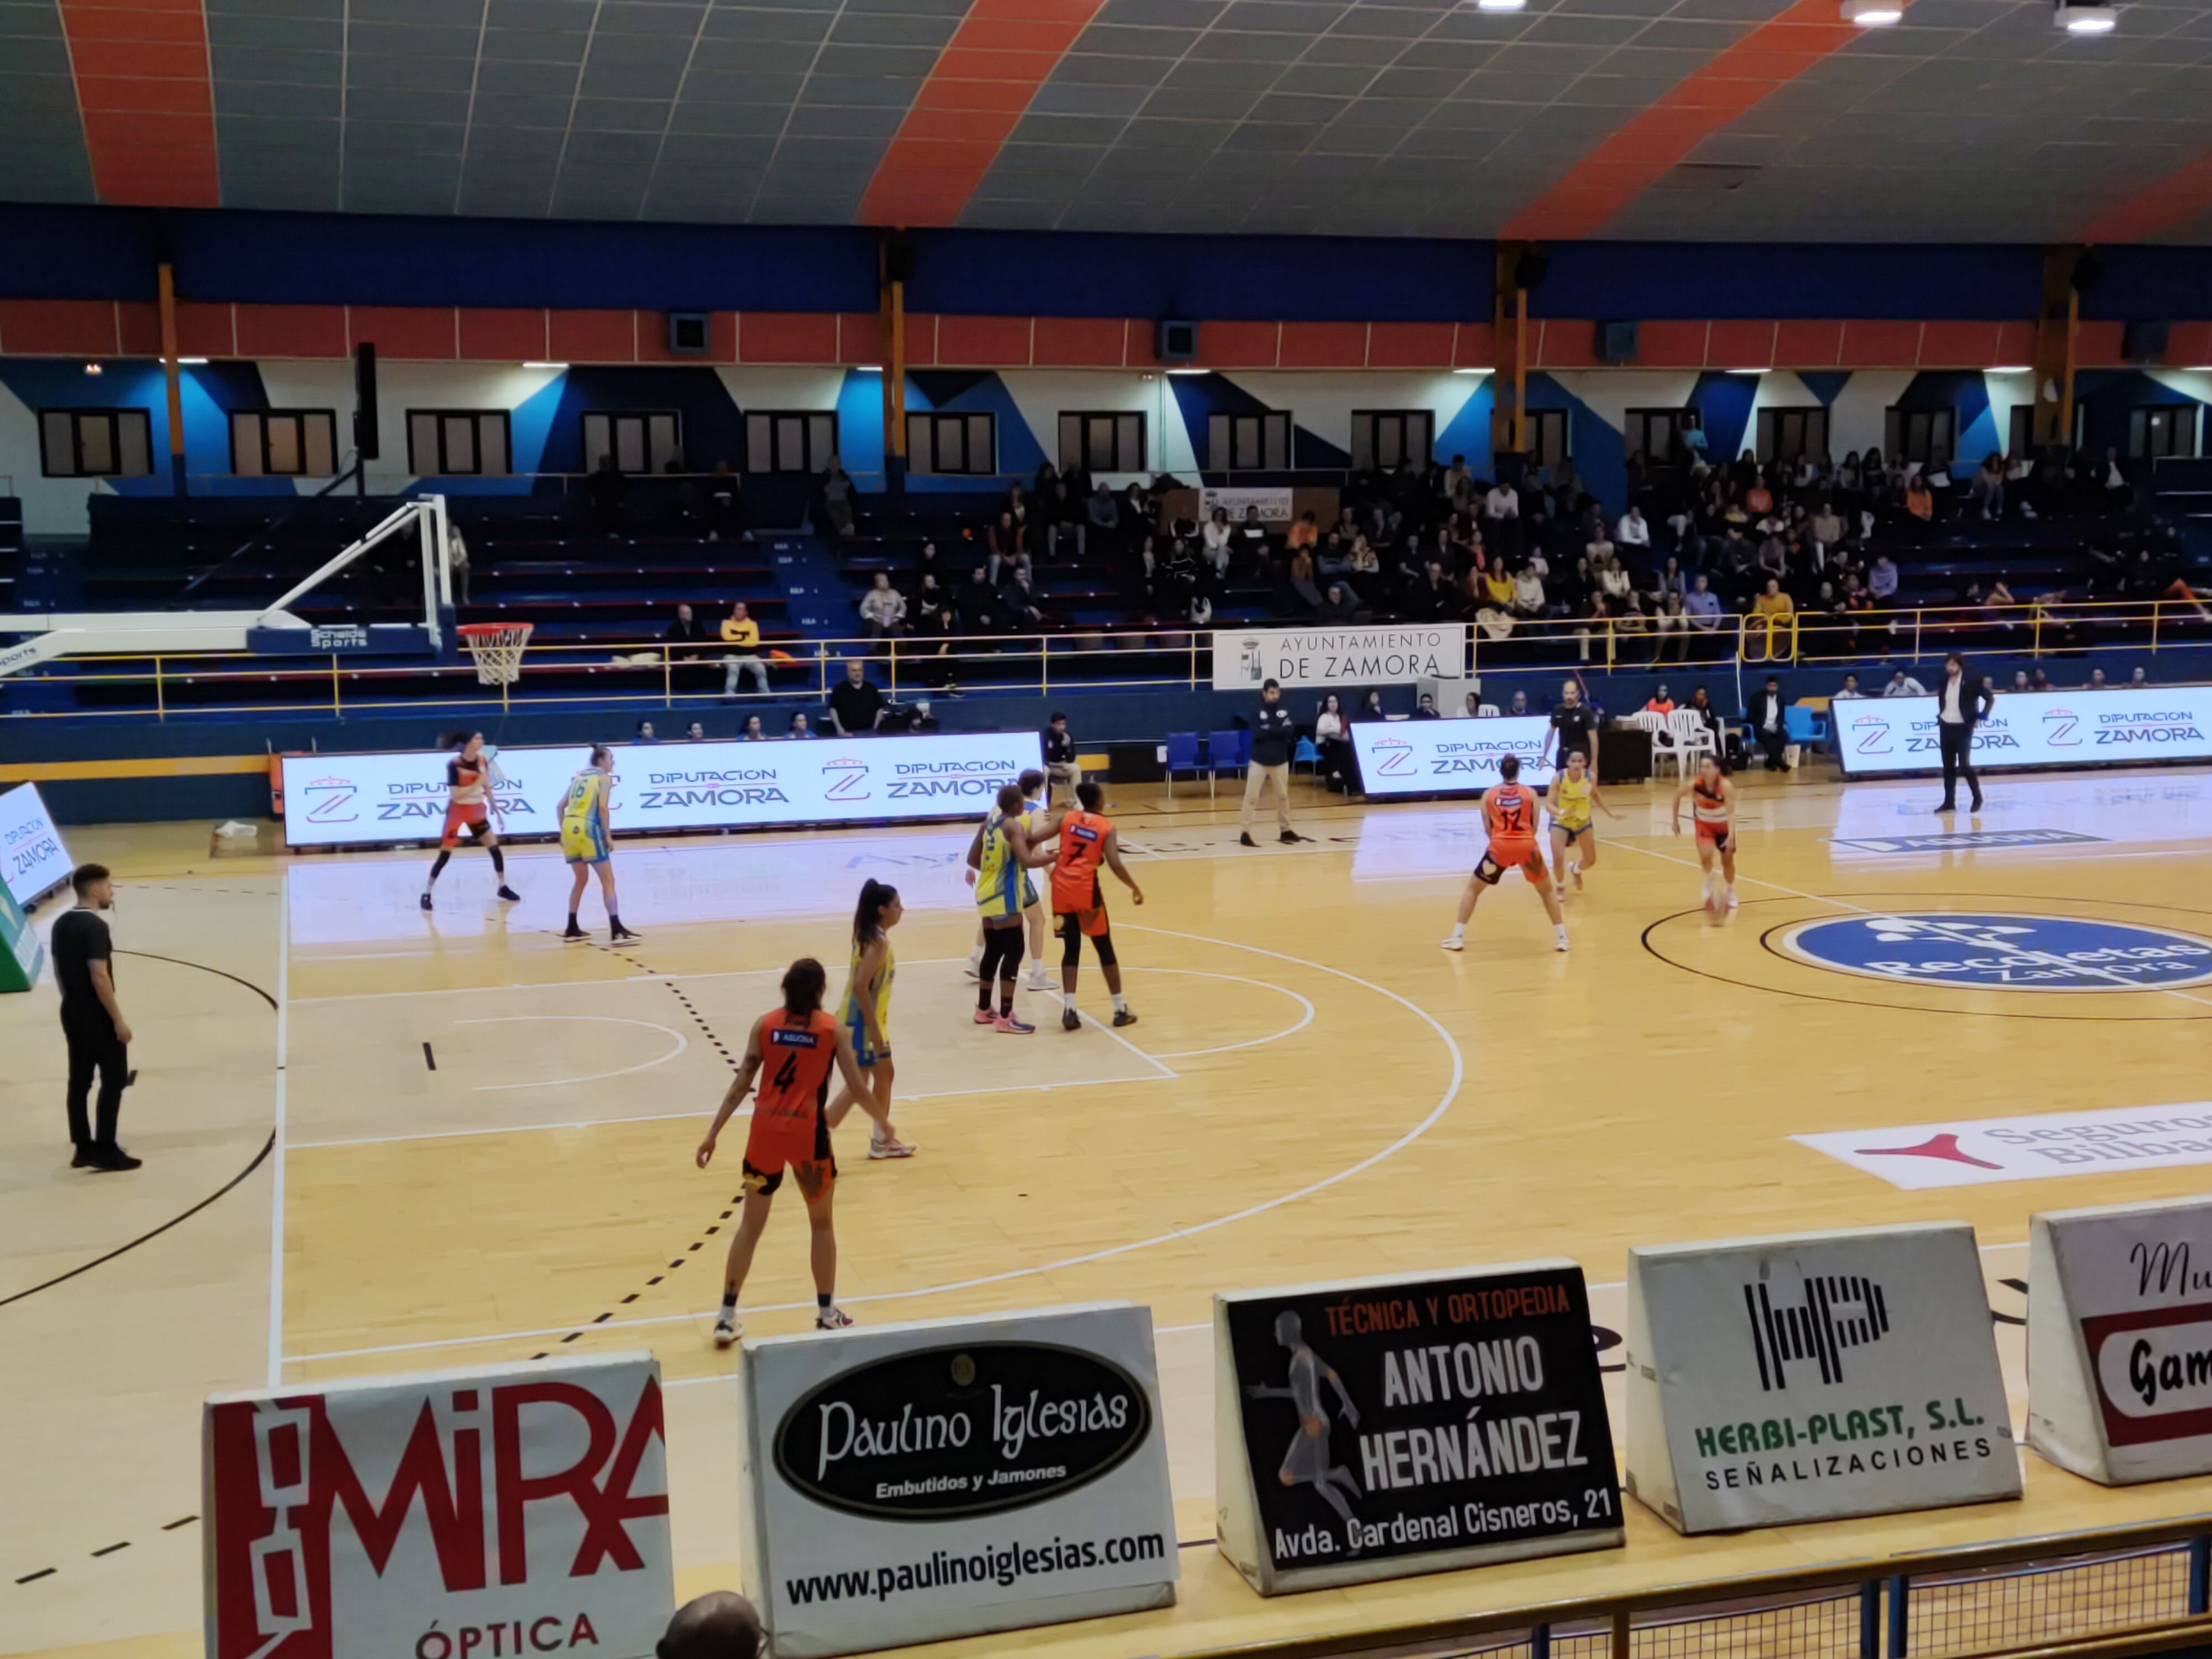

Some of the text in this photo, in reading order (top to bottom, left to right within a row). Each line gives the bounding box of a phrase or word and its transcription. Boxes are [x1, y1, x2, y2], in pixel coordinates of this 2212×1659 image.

[1238, 507, 1288, 519] ZMORA
[0, 647, 36, 666] ports
[1281, 632, 1441, 651] AYUNTAMIENTO
[1279, 653, 1439, 679] DE ZAMORA
[1906, 734, 2020, 752] ZAORA
[2094, 727, 2205, 744] ZAMORA
[1431, 756, 1556, 774] ZAMRA
[640, 788, 789, 808] ZAMORA
[12, 837, 60, 874] ZAMORA
[1065, 842, 1087, 867] 7
[1864, 944, 2211, 975] Recoletas
[774, 1051, 797, 1094] 4
[2026, 1136, 2212, 1164] Bilba
[1324, 1284, 1571, 1337] TÉCNICA Y ORTOPEDIA
[1384, 1335, 1544, 1407] ANTONIO
[817, 1384, 1128, 1481] Paulino Iglesias
[1694, 1397, 1985, 1458] HERBI-PLAST, S.L.
[1359, 1406, 1588, 1491] HERNÁNDEZ
[1705, 1438, 1991, 1491] SEÑALIZACIONES
[875, 1465, 1067, 1499] Embutidos y Jamones
[1275, 1488, 1611, 1559] Avda. Cardenal Cisneros, 21
[786, 1532, 1165, 1605] www.paulinoiglesias.com
[415, 1613, 599, 1659] ÓPTICA
